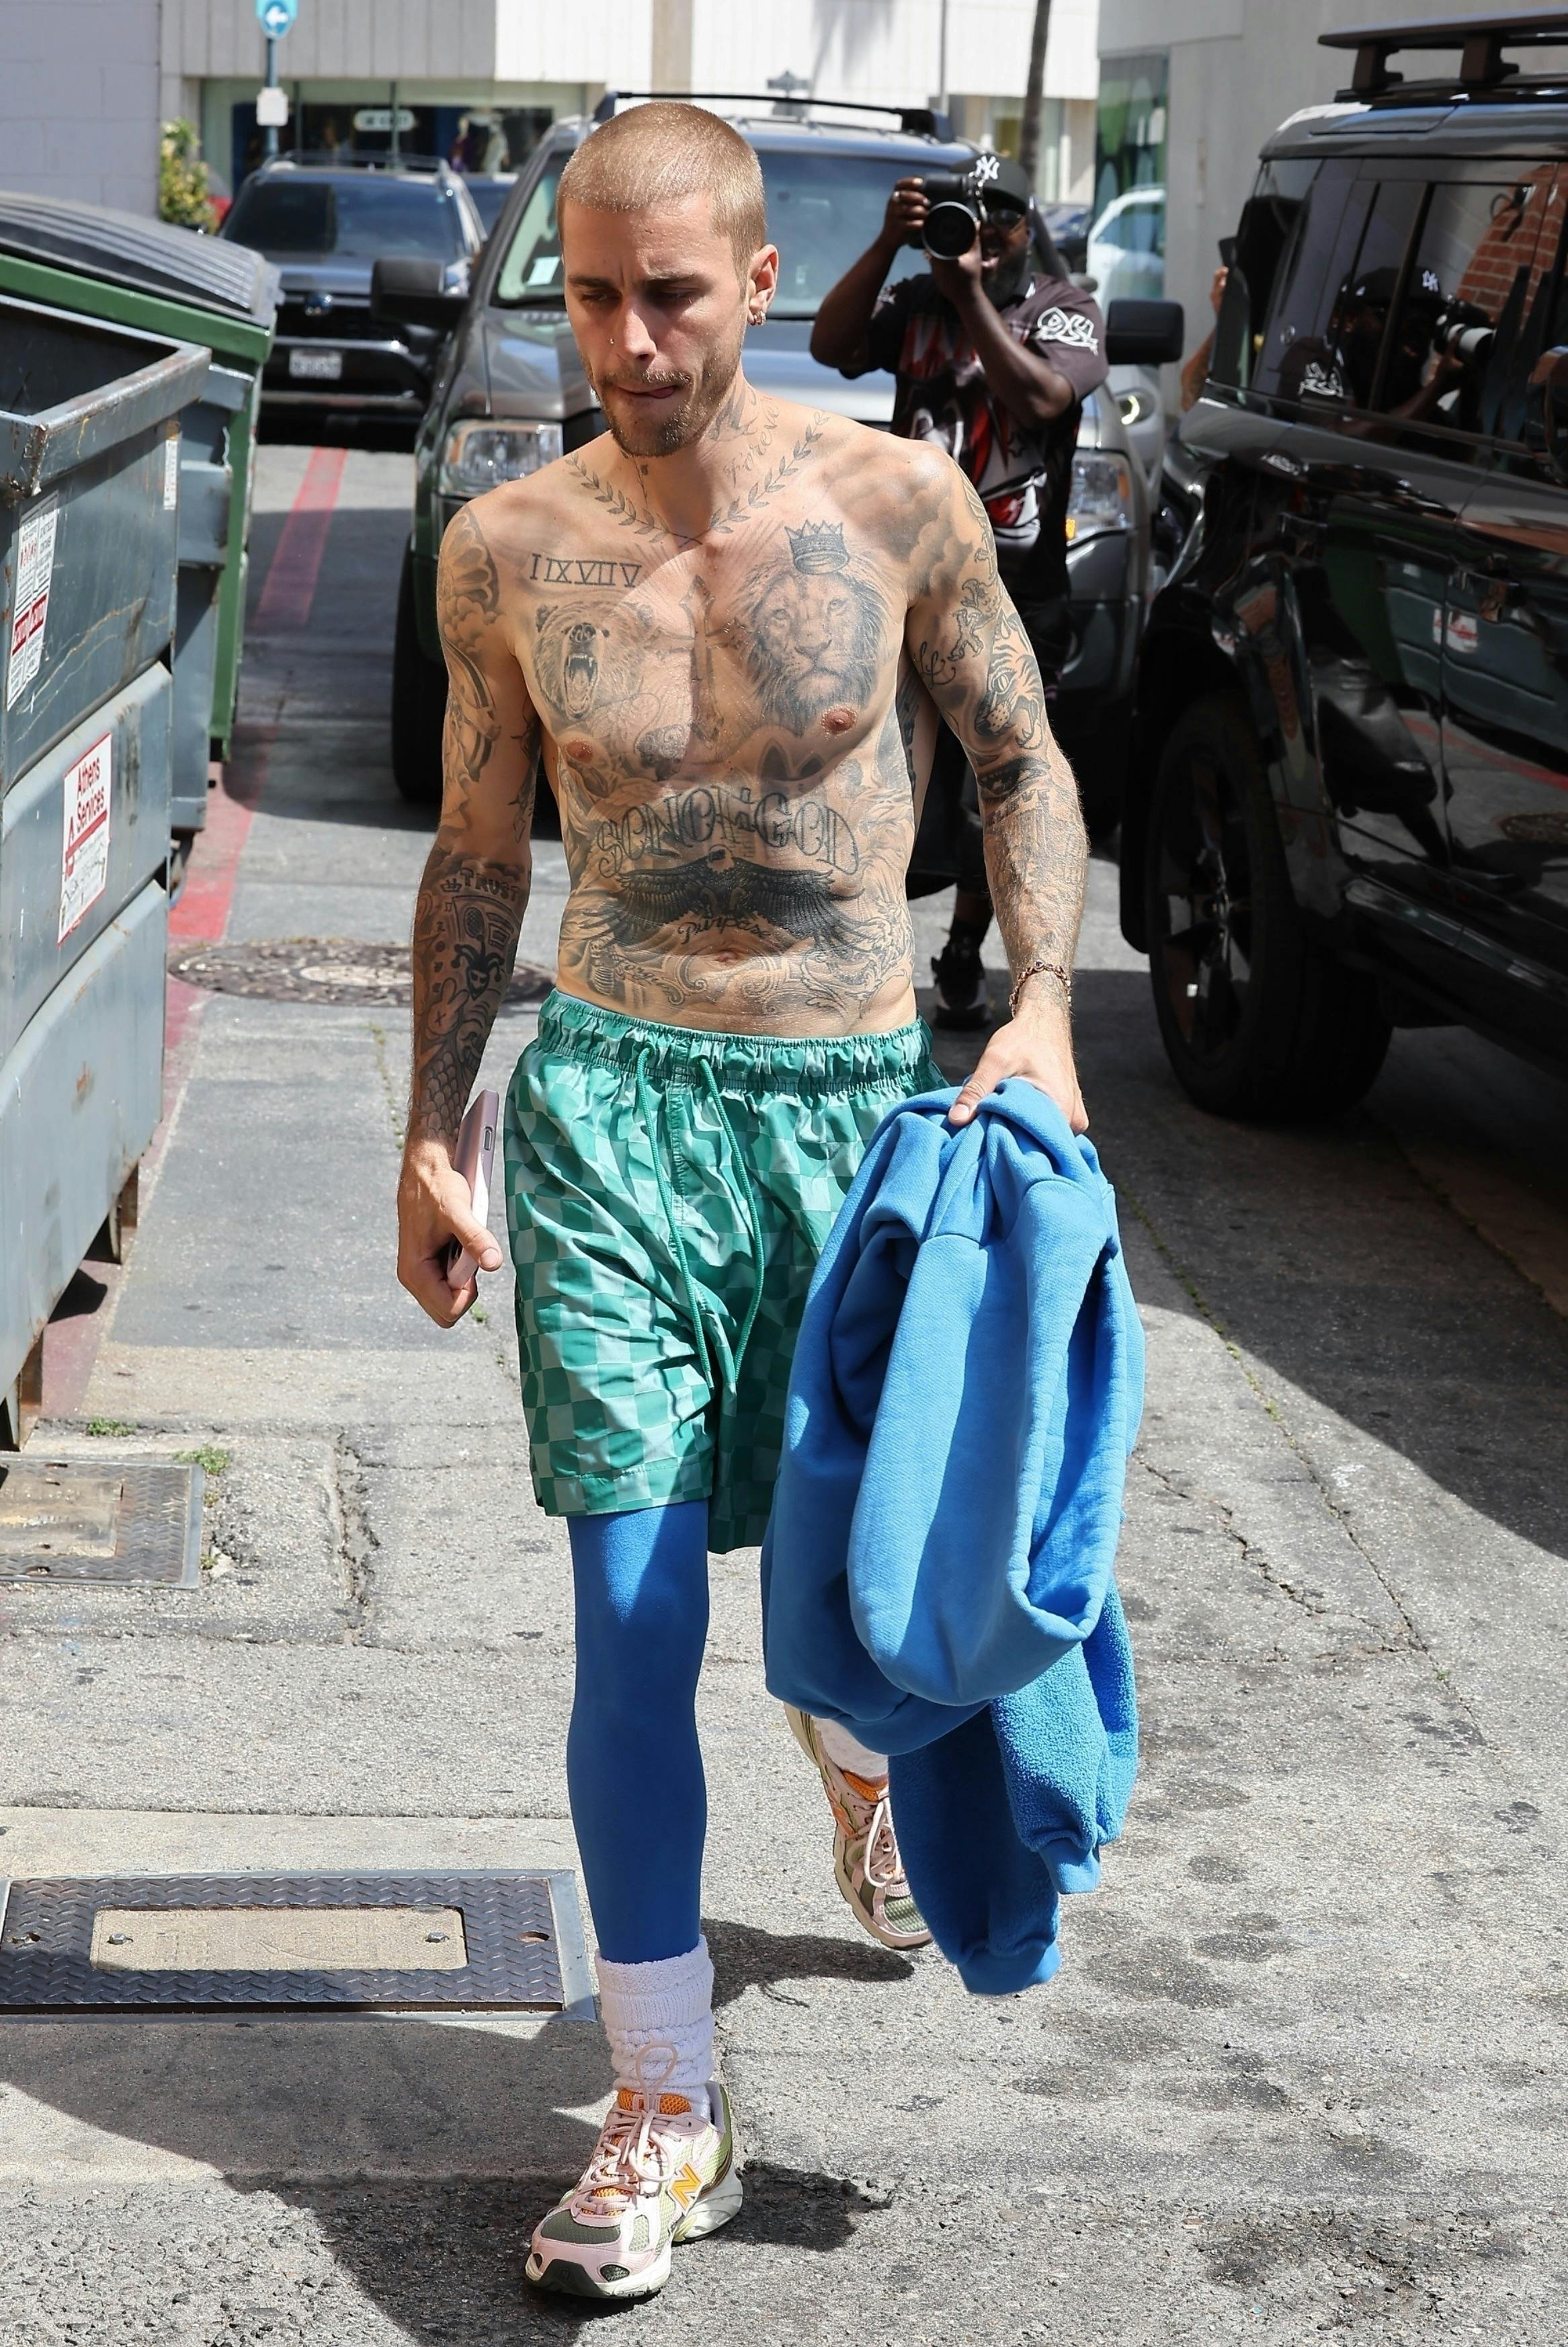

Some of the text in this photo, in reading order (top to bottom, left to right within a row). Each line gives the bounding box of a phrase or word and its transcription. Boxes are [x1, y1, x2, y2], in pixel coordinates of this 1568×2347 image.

[77, 757, 100, 800] Athens
[77, 785, 105, 833] Services
[460, 867, 522, 903] TRUST
[677, 915, 772, 945] Purpose
